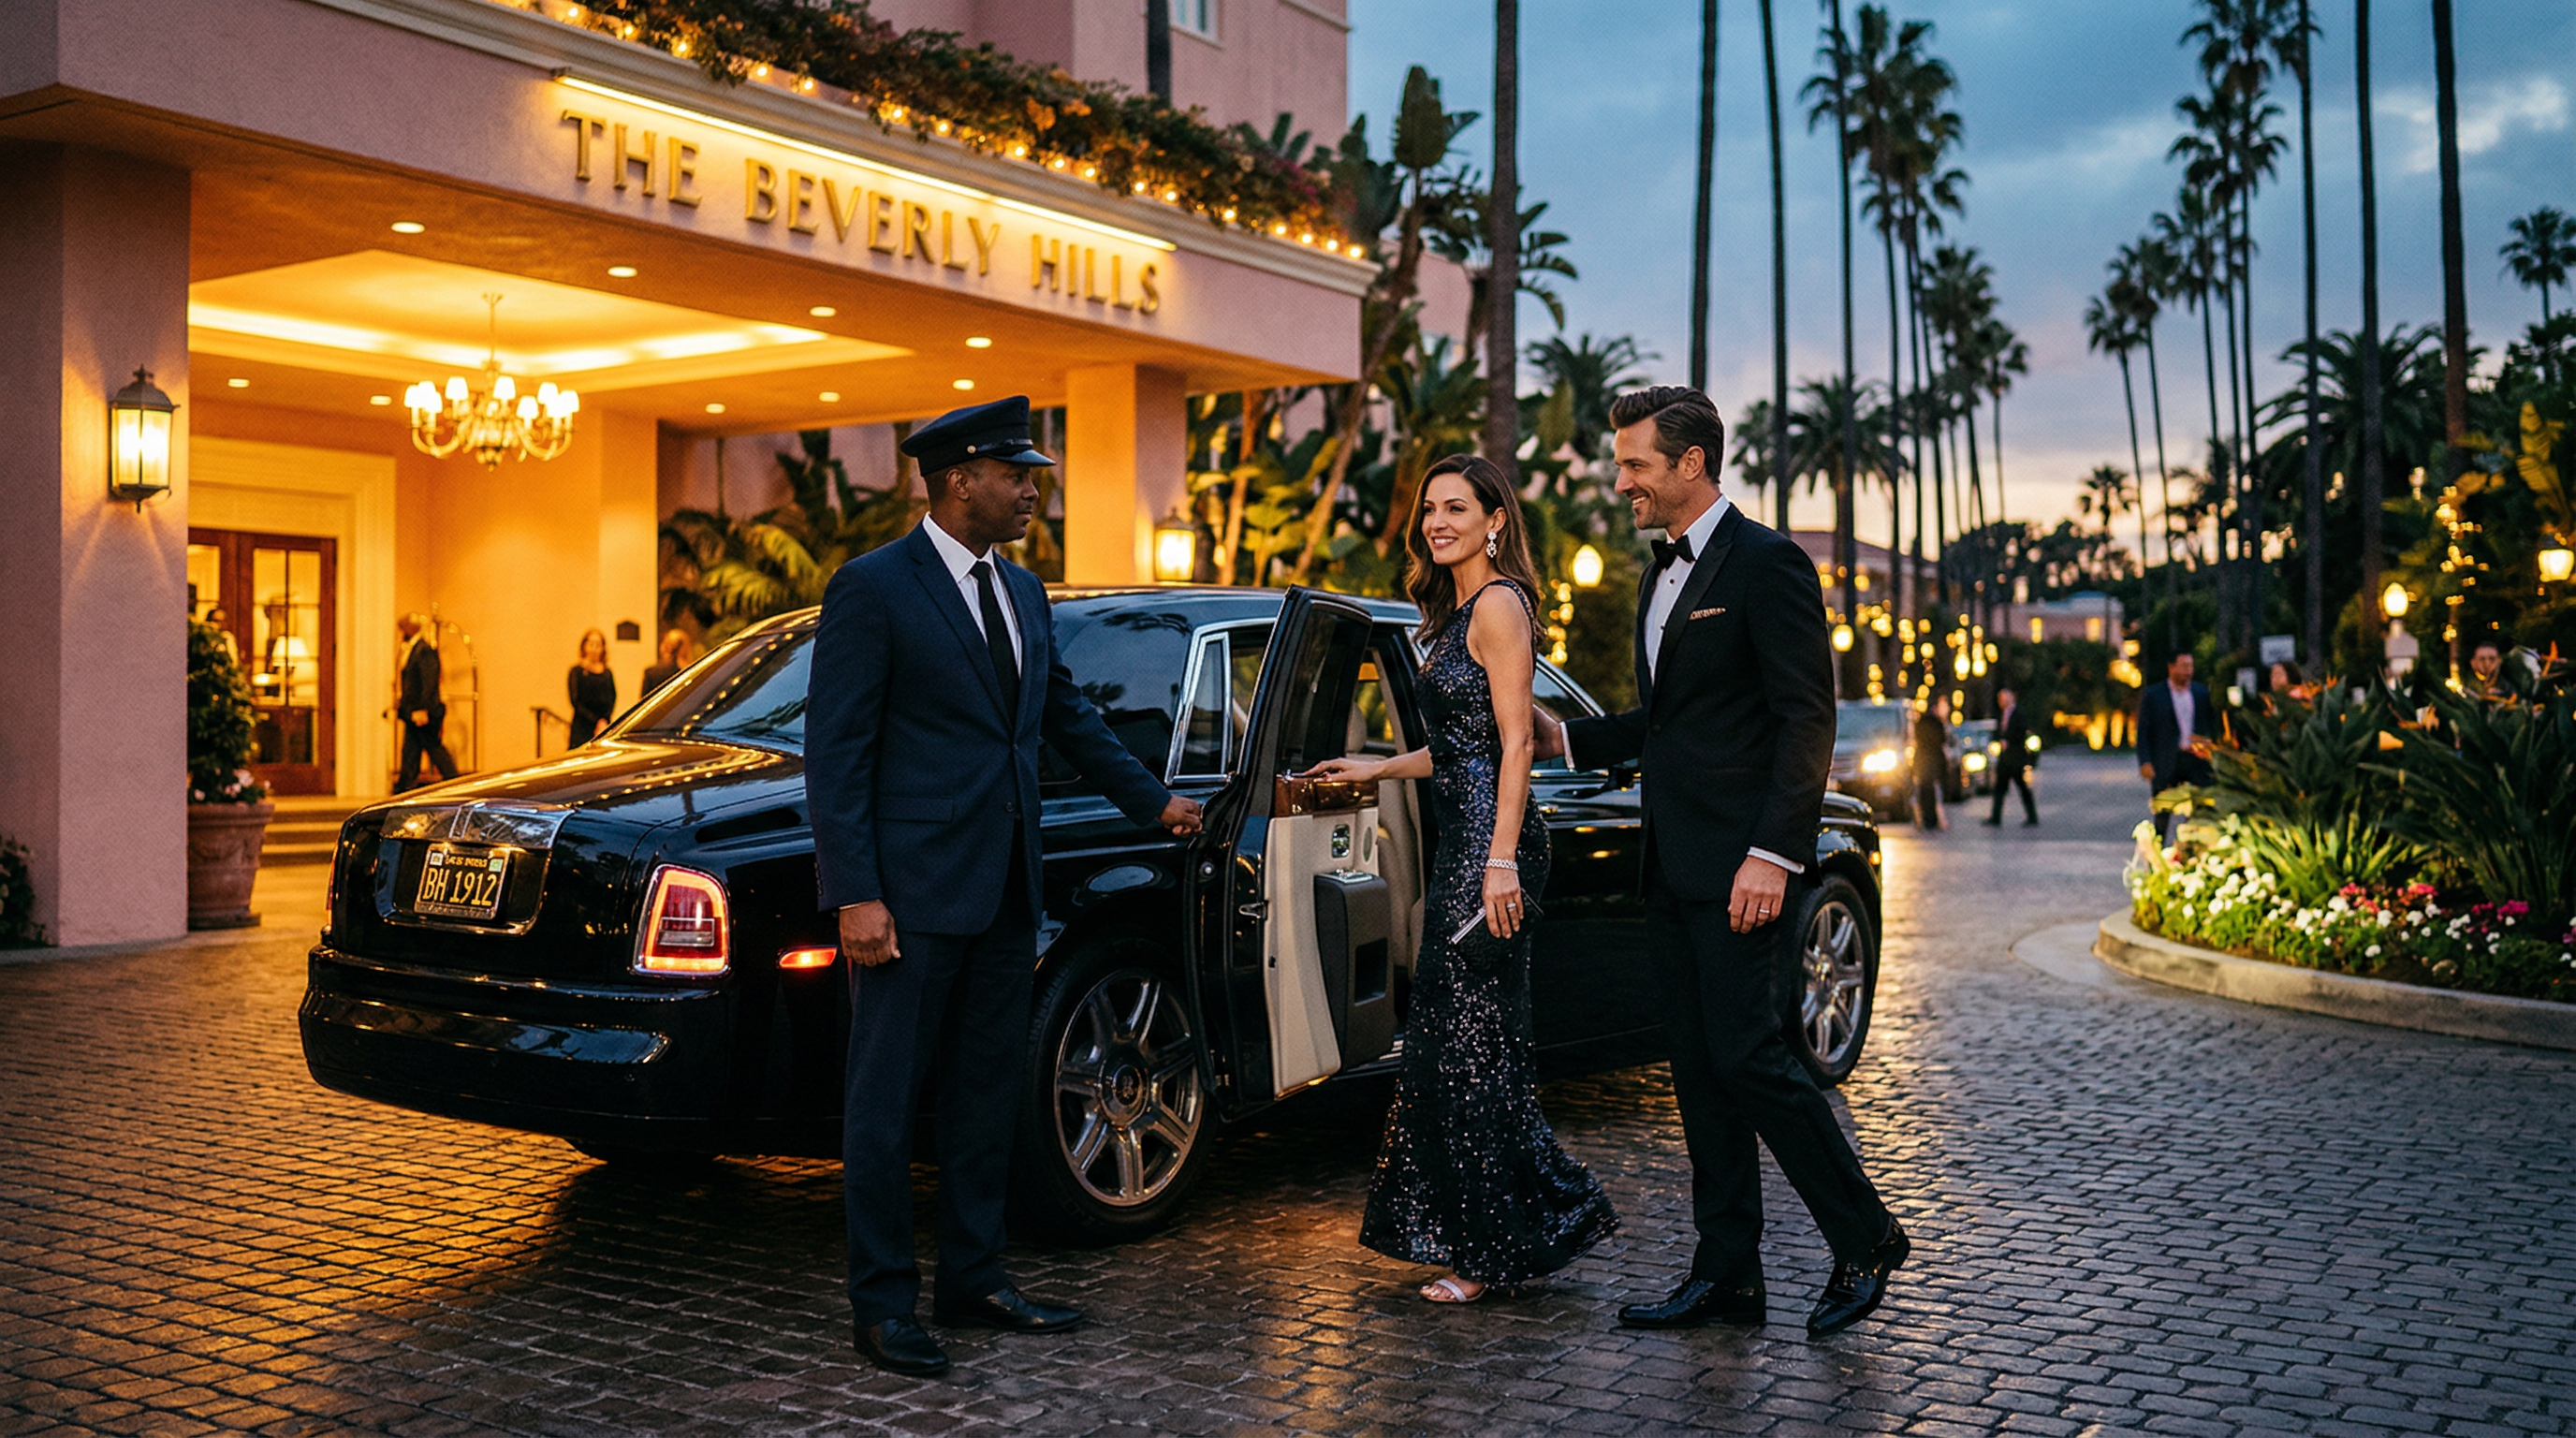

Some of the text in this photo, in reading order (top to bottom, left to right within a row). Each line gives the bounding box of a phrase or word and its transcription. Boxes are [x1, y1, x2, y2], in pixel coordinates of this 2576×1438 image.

[563, 110, 1159, 315] THE BEVERLY HILLS
[422, 867, 497, 907] BH 1912
